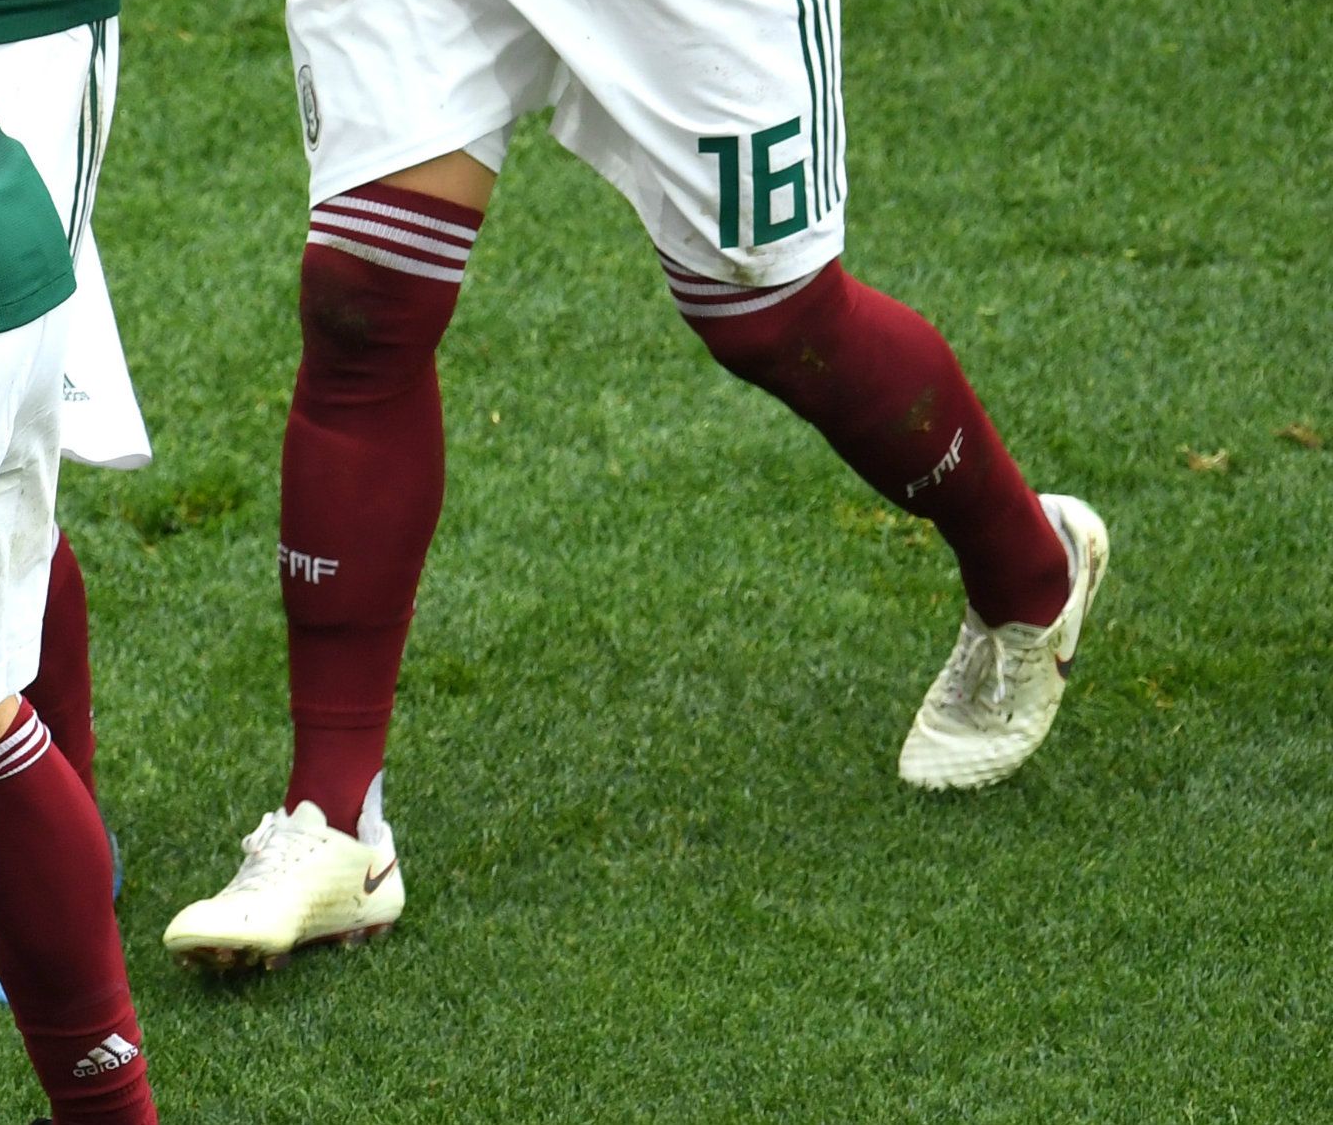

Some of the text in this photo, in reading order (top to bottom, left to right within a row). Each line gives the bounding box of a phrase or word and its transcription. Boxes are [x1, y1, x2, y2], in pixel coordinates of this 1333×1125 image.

[698, 115, 809, 250] 16
[906, 426, 964, 499] FMF
[73, 1044, 139, 1078] adidas
